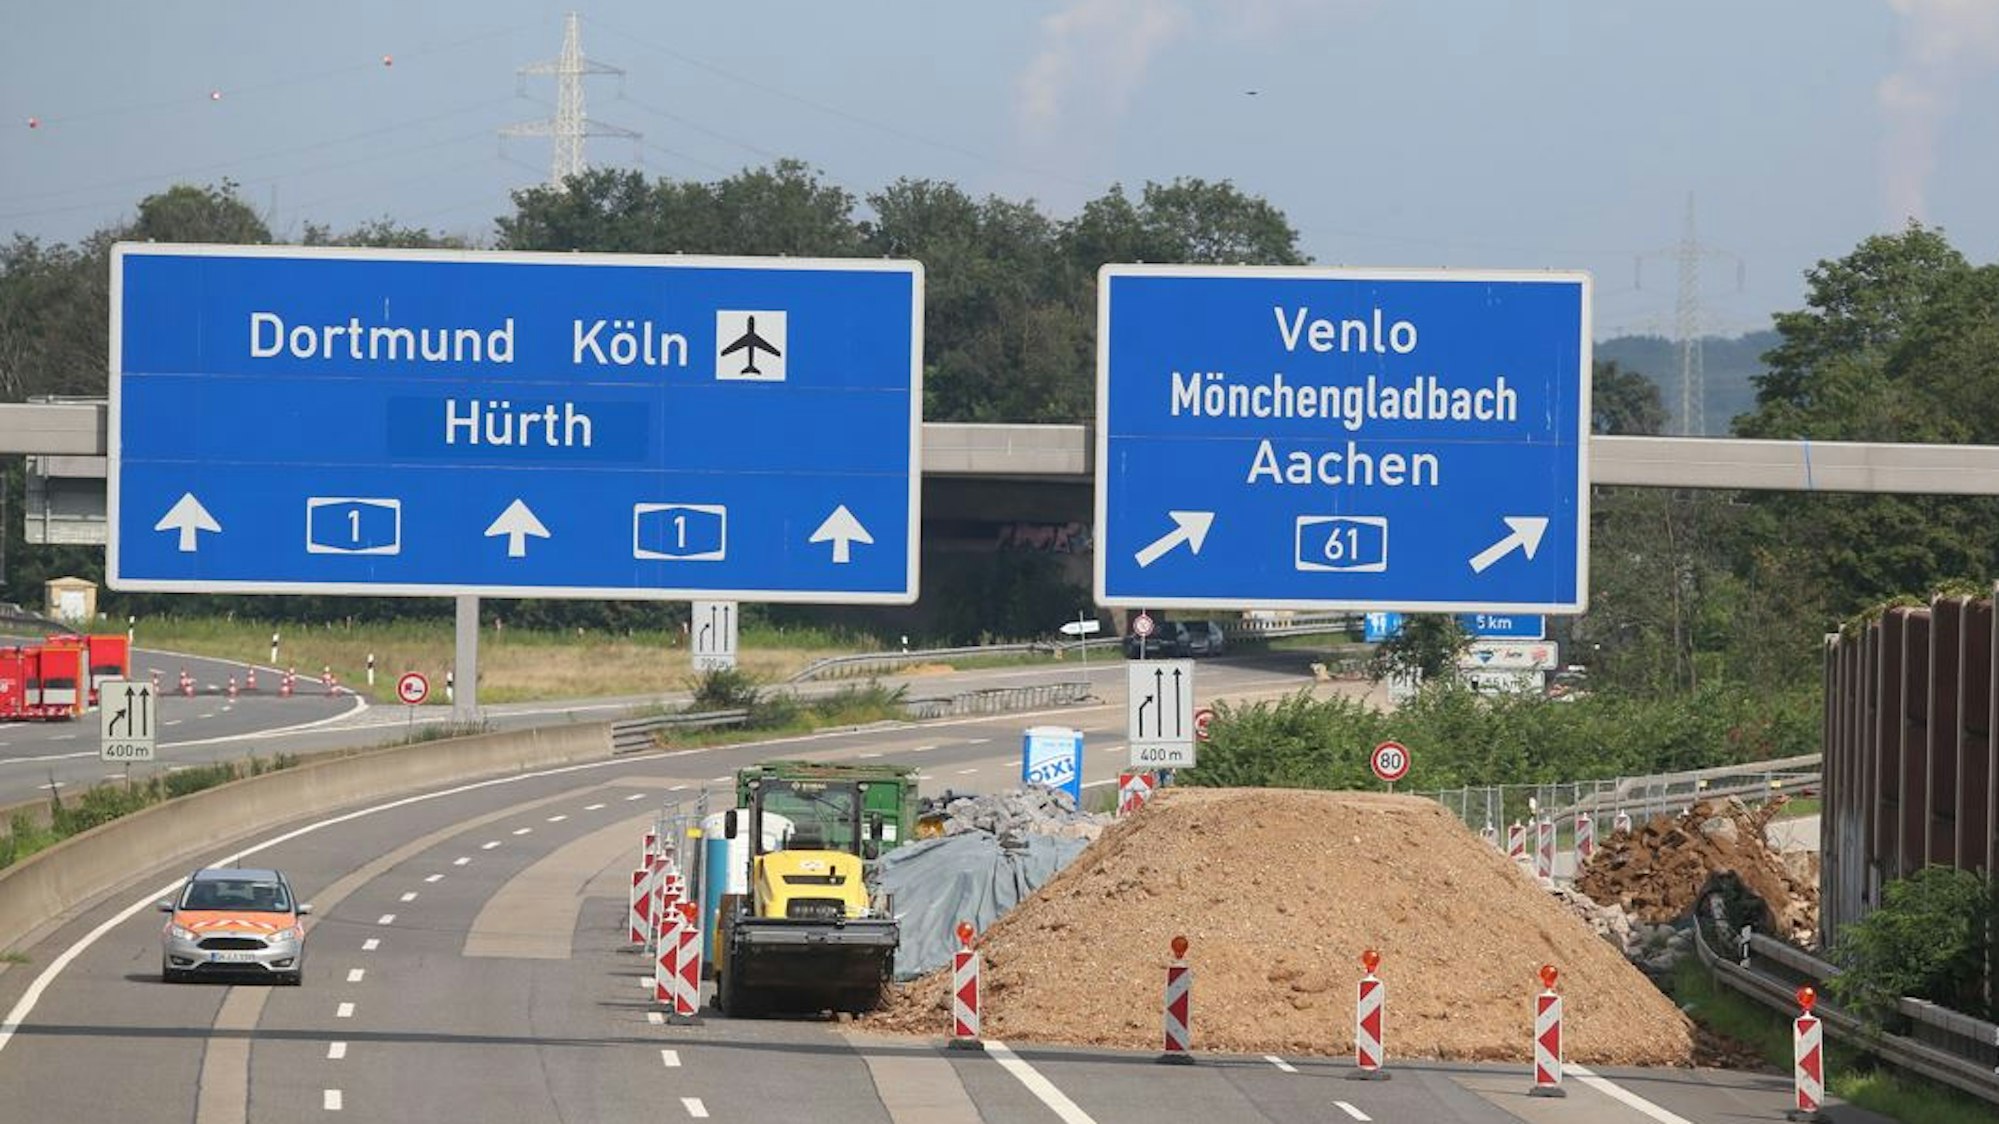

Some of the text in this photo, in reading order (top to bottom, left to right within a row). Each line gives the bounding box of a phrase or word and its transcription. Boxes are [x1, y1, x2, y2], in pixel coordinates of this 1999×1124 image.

[251, 312, 689, 366] Dortmund Köln
[1274, 306, 1417, 354] Venlo
[1171, 372, 1518, 431] Mönchengladbach
[446, 399, 593, 447] Hürth
[1247, 439, 1439, 486] Aachen
[348, 509, 360, 544] 1
[673, 515, 686, 549] 1
[1324, 527, 1358, 560] 61
[1488, 615, 1512, 629] km
[106, 744, 134, 757] 400
[1140, 748, 1166, 761] 400
[1380, 752, 1402, 769] 80
